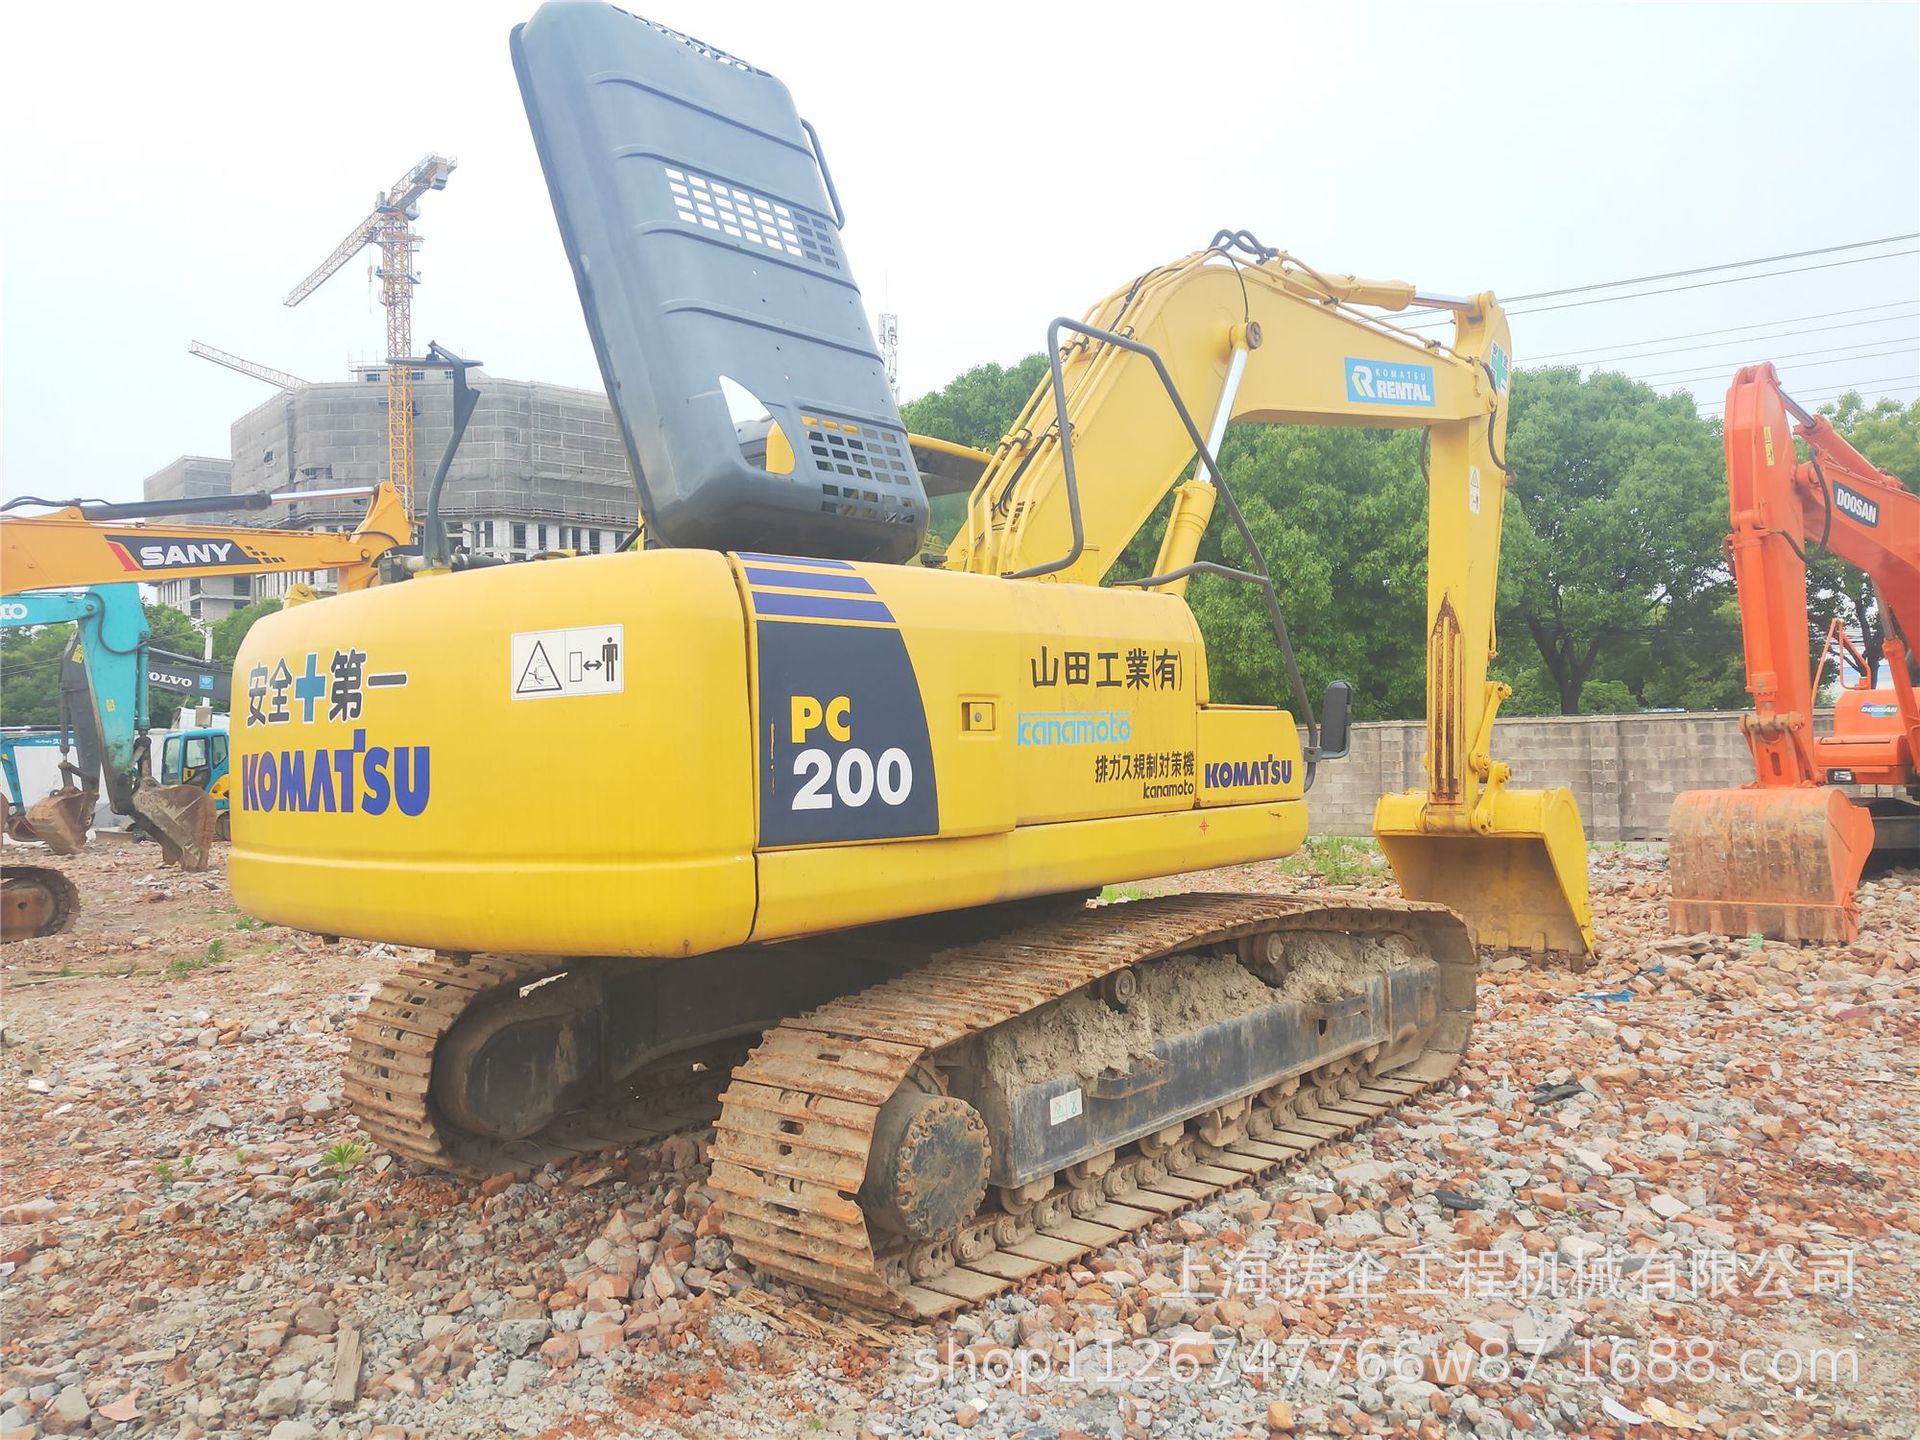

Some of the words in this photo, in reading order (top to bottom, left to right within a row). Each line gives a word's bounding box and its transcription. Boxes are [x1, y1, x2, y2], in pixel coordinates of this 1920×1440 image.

[1376, 380, 1431, 402] RENTAL
[1836, 488, 1877, 523] DOOSAN
[140, 543, 232, 566] SANY
[148, 672, 193, 687] OLVO
[791, 695, 851, 743] PC
[1017, 711, 1131, 746] kanamoto
[242, 729, 431, 816] KOMATSU
[791, 747, 913, 810] 200
[1095, 751, 1195, 783] 排ガス規制対策機
[1204, 754, 1292, 788] KOMATSU
[1142, 782, 1194, 799] kanamoto
